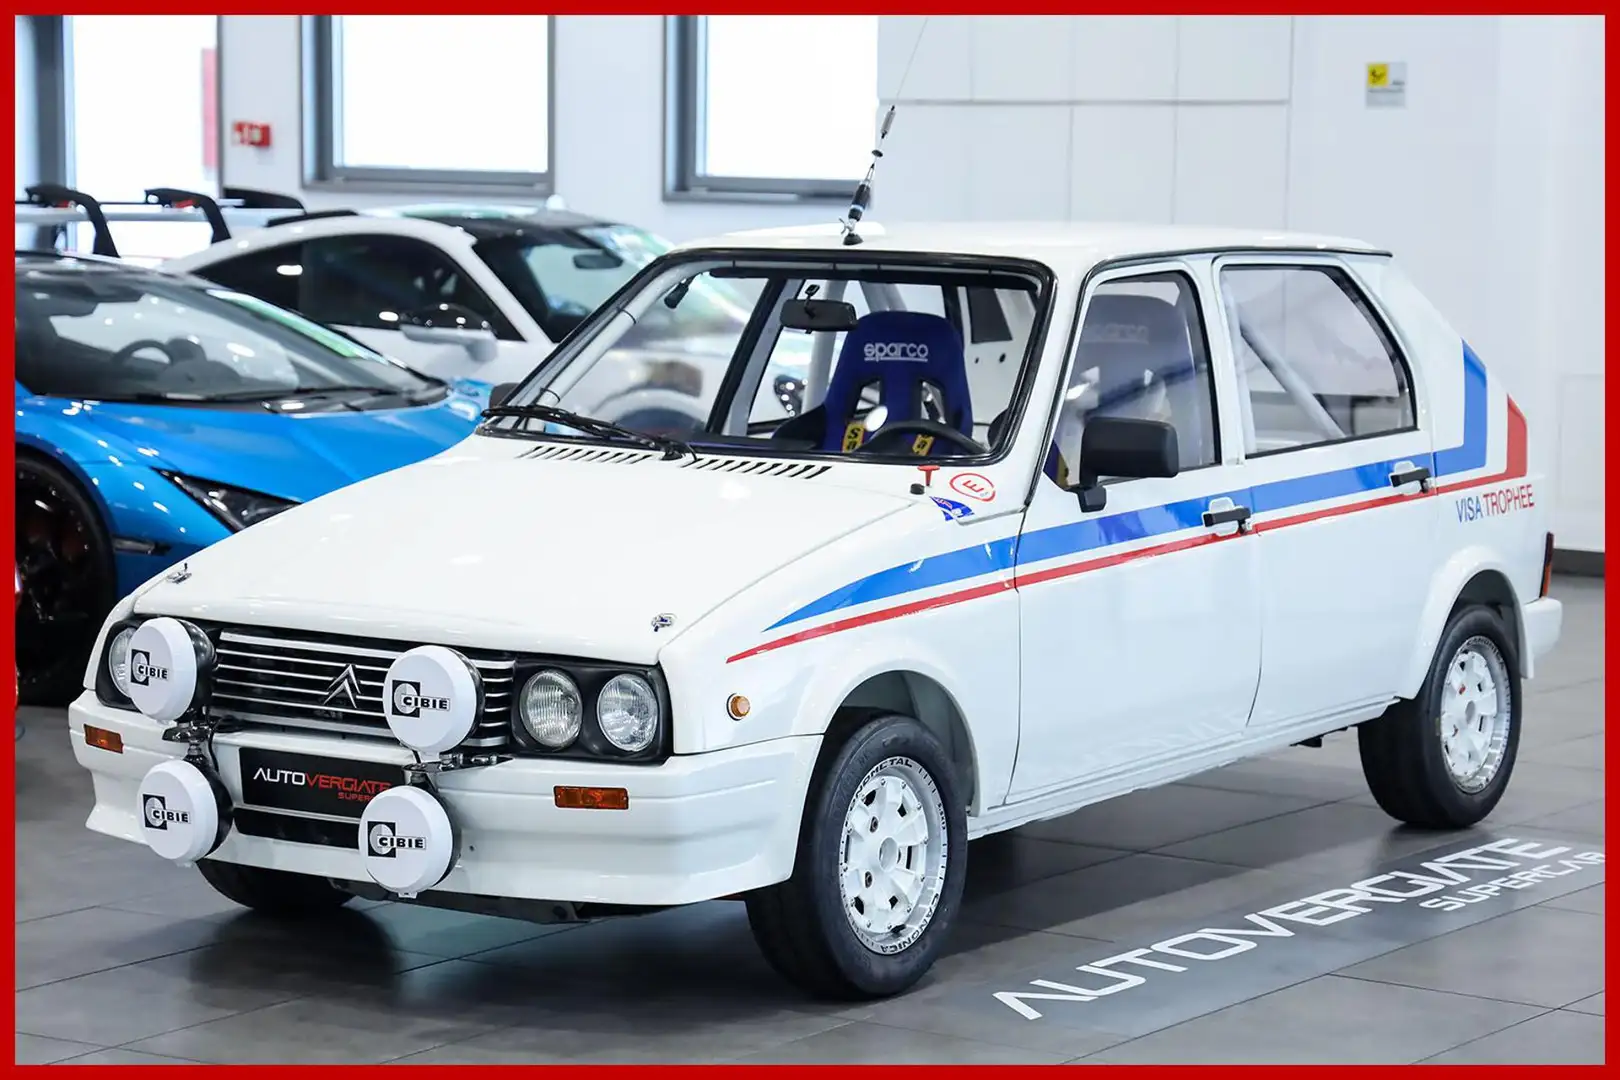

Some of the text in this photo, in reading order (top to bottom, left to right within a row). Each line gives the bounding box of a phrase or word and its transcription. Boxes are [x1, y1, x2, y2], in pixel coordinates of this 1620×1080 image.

[863, 342, 929, 361] sparco
[1455, 484, 1535, 523] VISA TROPHEE
[253, 767, 392, 794] AUTOVERGIATE
[337, 791, 373, 802] SUPER
[880, 892, 940, 953] CANONICA
[992, 838, 1573, 1020] AUTOVERGIATE
